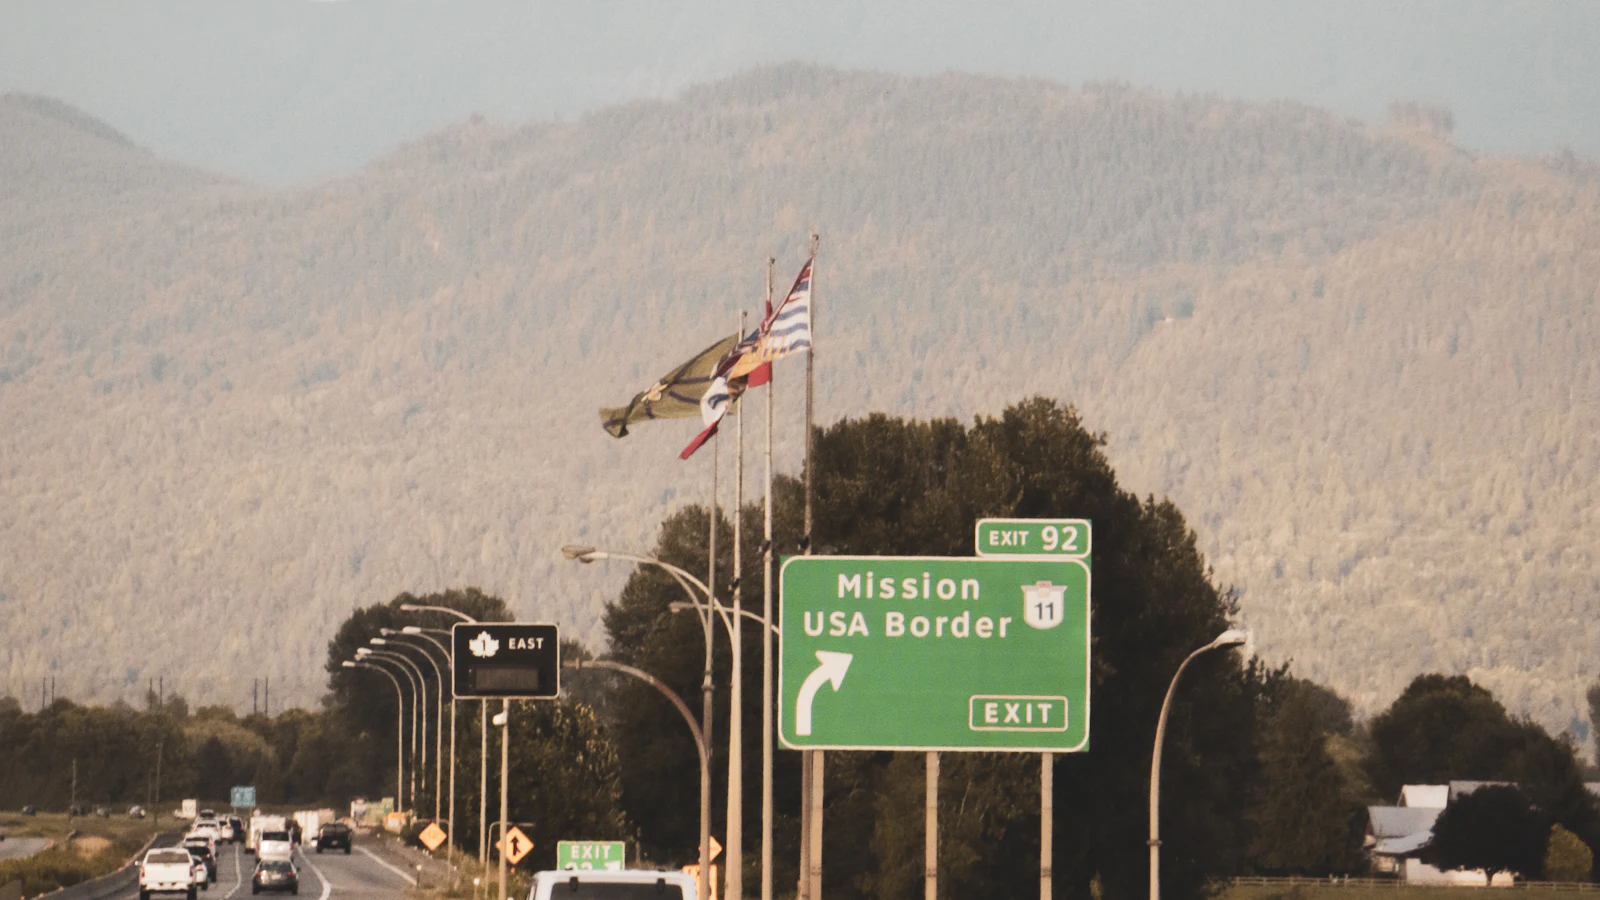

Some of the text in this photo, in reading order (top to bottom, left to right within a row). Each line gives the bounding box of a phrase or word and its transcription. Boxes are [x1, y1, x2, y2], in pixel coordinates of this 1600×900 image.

[989, 526, 1078, 551] EXIT 92
[838, 571, 980, 600] Mission
[1034, 602, 1054, 621] 11
[804, 611, 1012, 638] USA Border
[508, 637, 544, 650] EAST
[984, 703, 1053, 723] EXIT
[571, 844, 611, 859] EXIT
